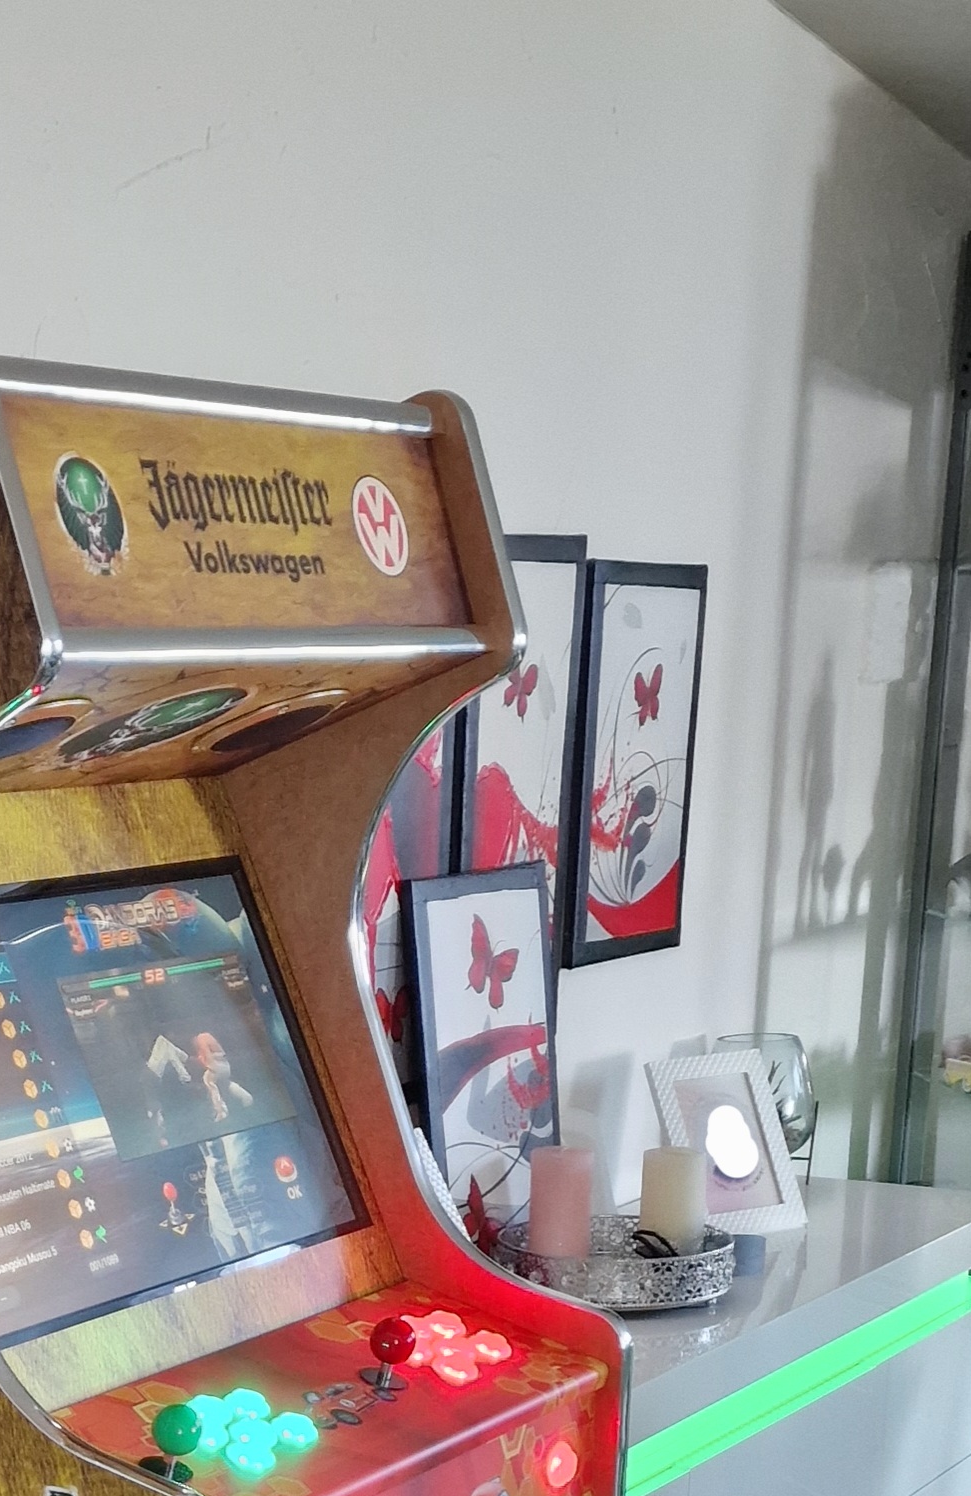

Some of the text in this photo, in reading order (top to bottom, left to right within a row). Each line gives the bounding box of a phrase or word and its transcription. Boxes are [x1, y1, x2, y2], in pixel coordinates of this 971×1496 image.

[183, 539, 325, 582] Volkswagen
[144, 968, 165, 984] 52
[287, 1185, 303, 1200] OK
[4, 1222, 21, 1238] NBA
[21, 1219, 31, 1231] 06
[27, 1248, 51, 1265] Musou
[51, 1246, 58, 1257] 5
